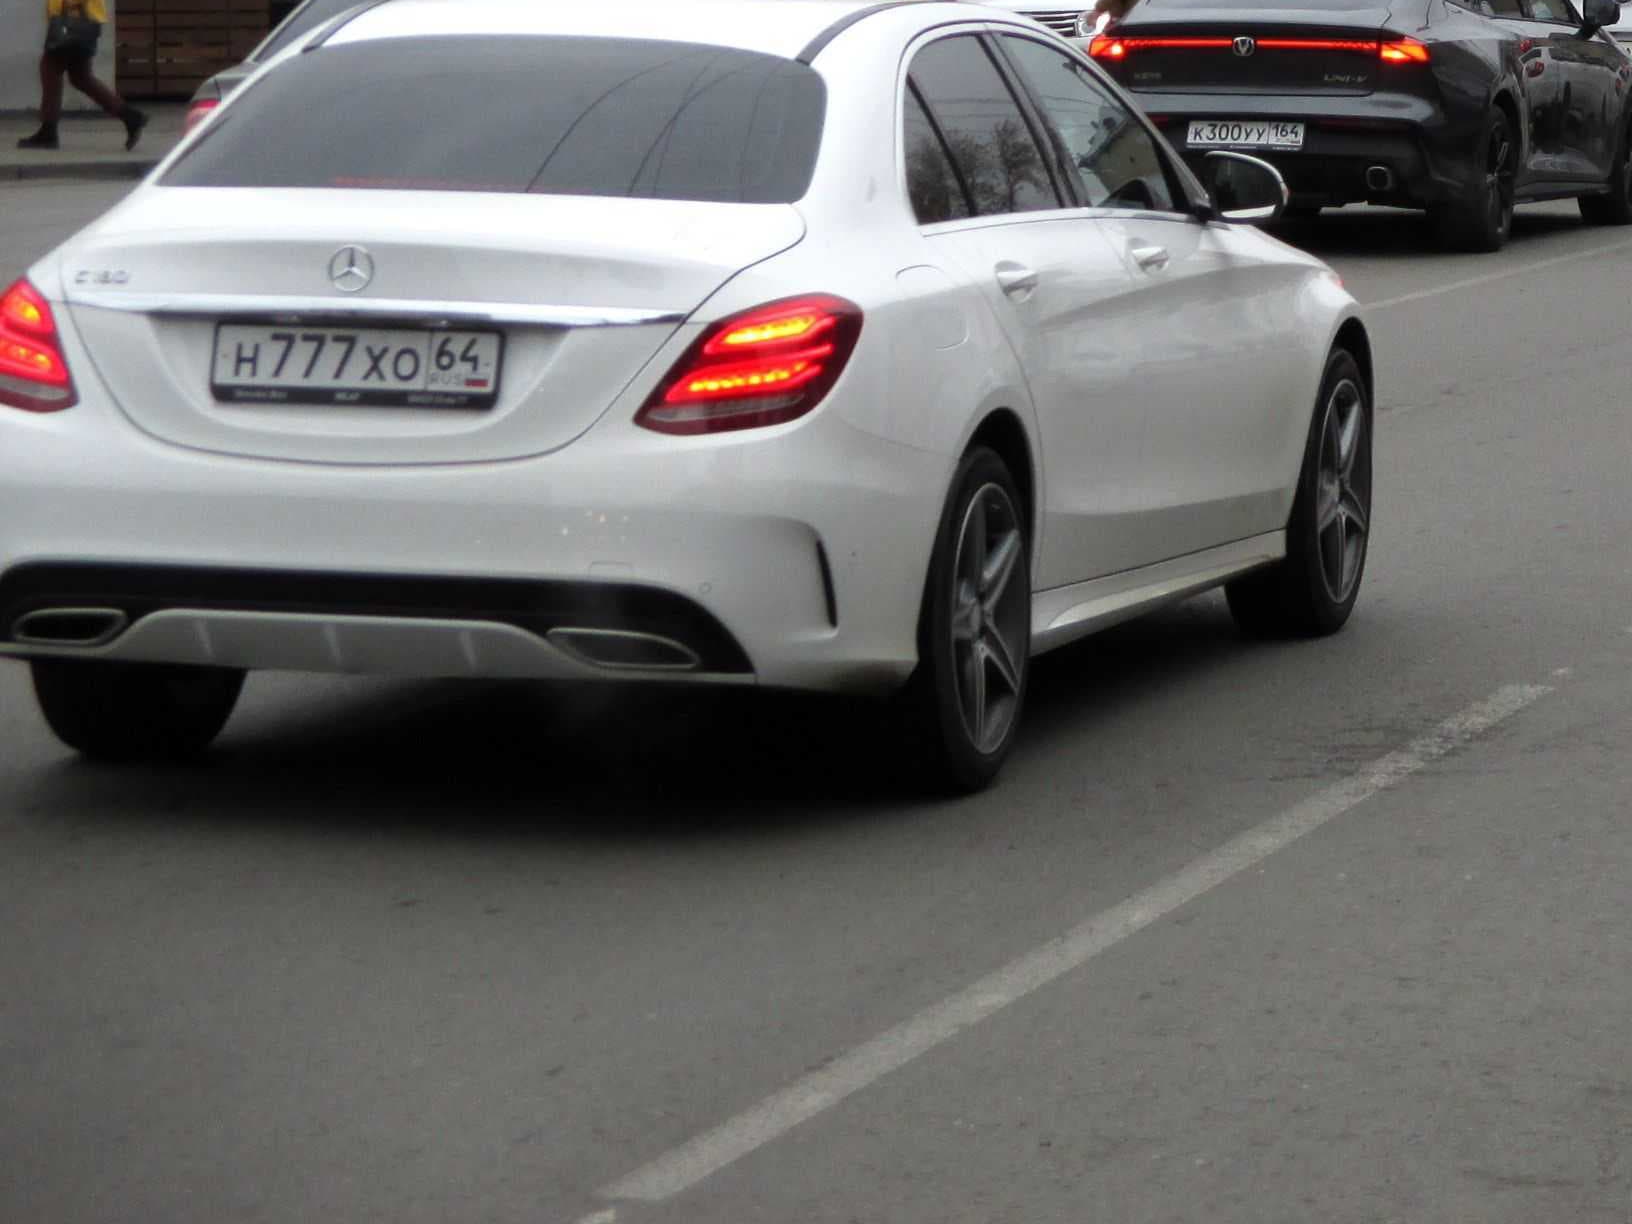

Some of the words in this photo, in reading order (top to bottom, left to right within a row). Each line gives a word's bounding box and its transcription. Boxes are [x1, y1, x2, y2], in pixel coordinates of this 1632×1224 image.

[1271, 125, 1300, 140] 164
[234, 332, 421, 382] Н777ХО
[435, 337, 480, 373] 64
